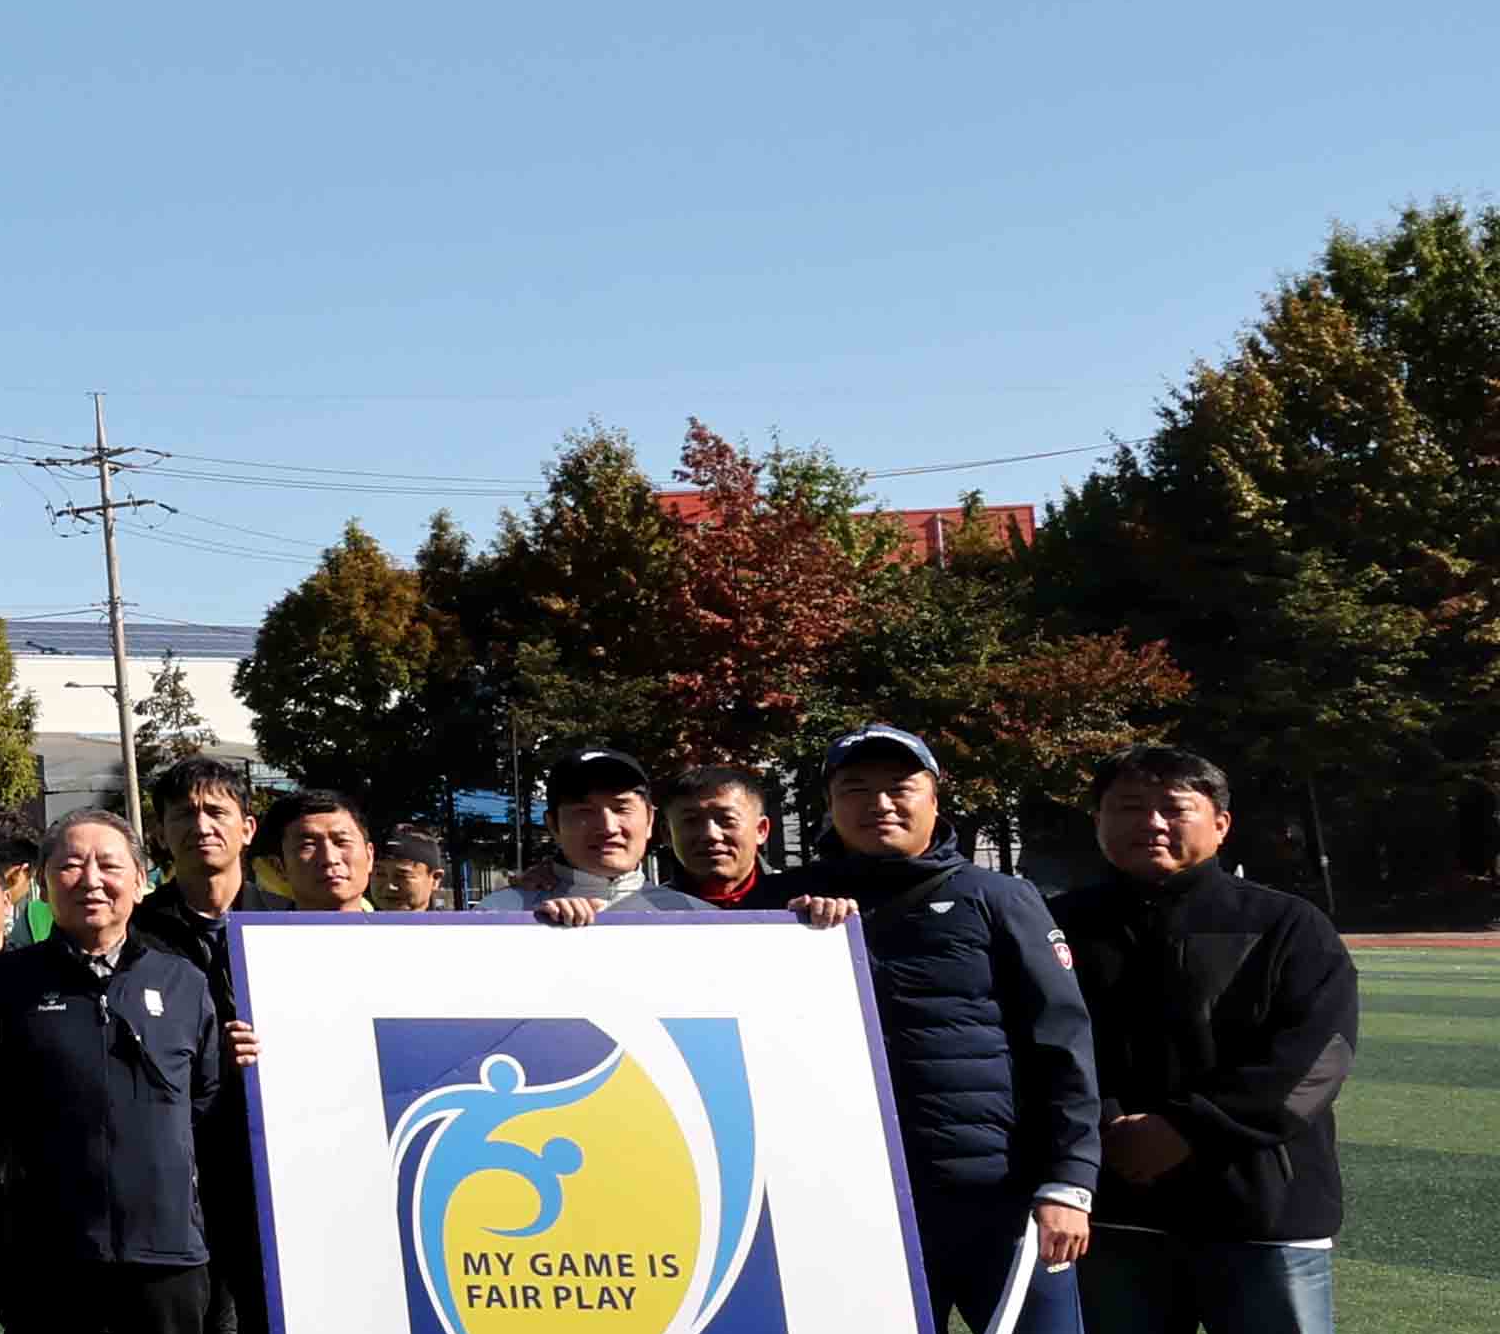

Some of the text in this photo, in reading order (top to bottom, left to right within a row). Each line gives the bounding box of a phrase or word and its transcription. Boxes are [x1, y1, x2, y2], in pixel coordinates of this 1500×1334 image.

[462, 1252, 680, 1278] MY GAME IS
[466, 1284, 637, 1311] FAIR PLAY
